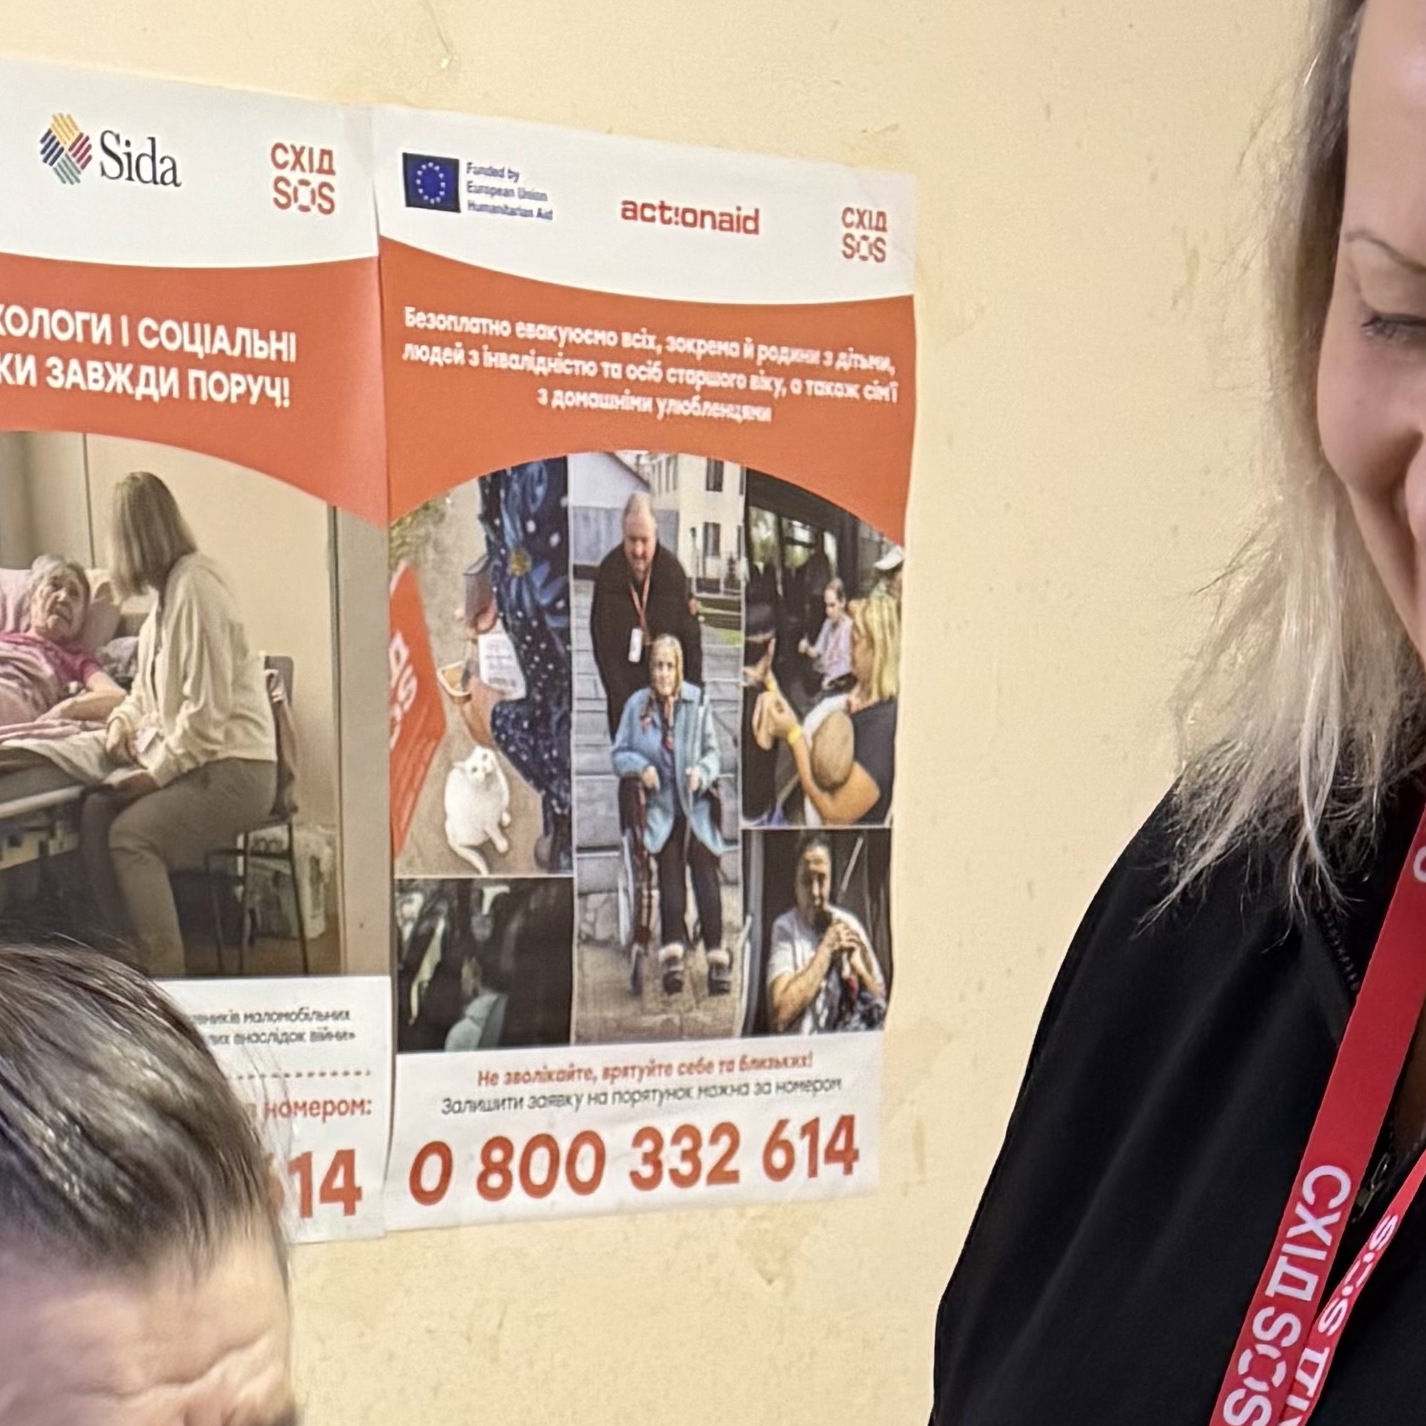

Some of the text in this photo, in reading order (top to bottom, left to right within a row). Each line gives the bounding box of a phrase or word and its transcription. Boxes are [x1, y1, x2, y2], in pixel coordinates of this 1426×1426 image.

[99, 130, 182, 188] Sida
[271, 142, 336, 176] СХІД
[273, 176, 336, 215] SOS
[841, 206, 887, 232] СХІД
[842, 233, 887, 264] SOS
[121, 315, 129, 347] І
[137, 320, 296, 363] СОЦІАЛЬНІ
[46, 361, 179, 402] ЗАВЖДИ
[188, 371, 291, 408] ПОРУЧ!
[264, 1098, 372, 1124] номером:
[409, 1114, 861, 1206] 0 800 332 614
[1265, 1164, 1352, 1302] СХІД
[1318, 1214, 1399, 1336] SOS
